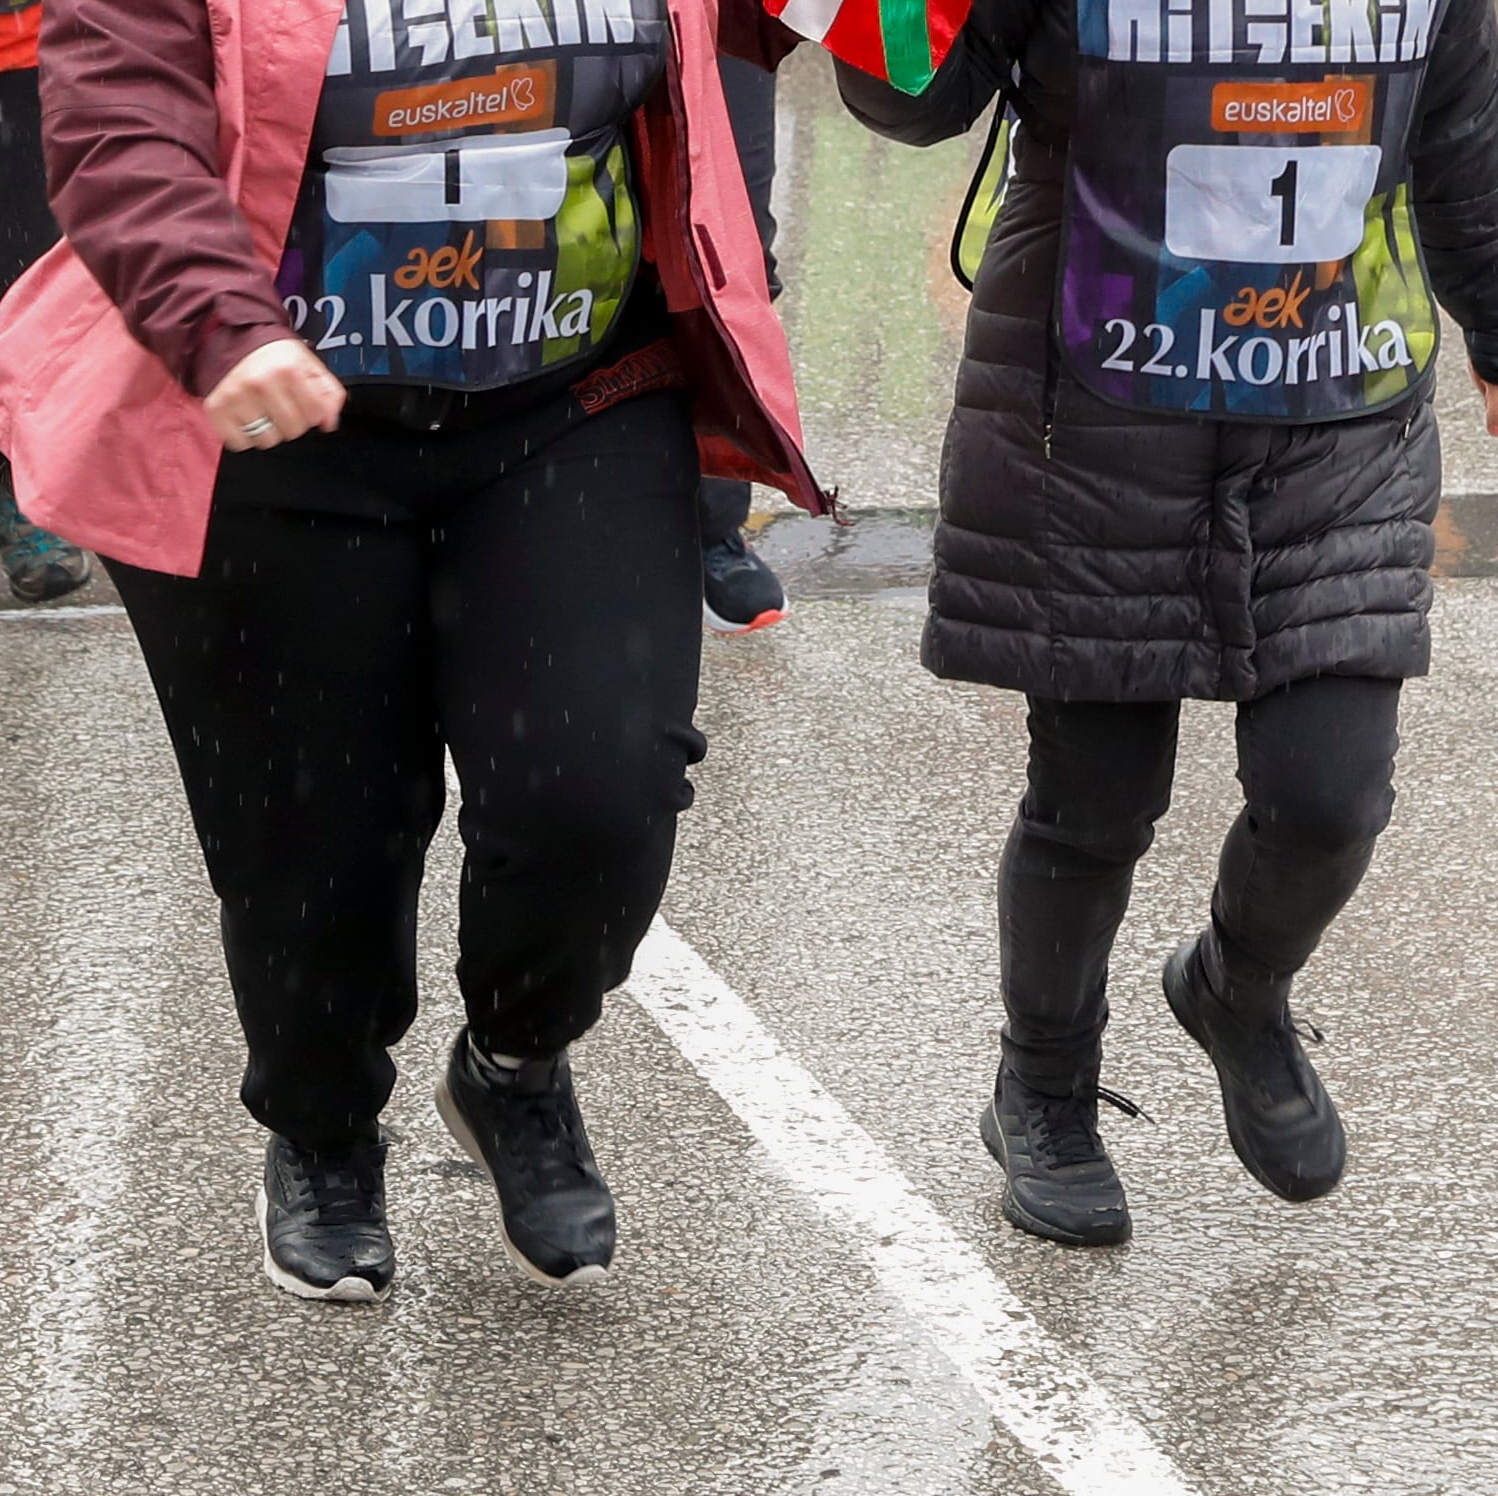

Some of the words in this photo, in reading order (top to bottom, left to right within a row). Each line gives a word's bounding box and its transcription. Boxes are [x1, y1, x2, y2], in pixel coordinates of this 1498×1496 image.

[387, 86, 509, 130] euskaltel
[1224, 94, 1333, 124] euskaltel
[1269, 160, 1297, 248] 1
[393, 228, 484, 291] aek
[1222, 269, 1313, 330] aek
